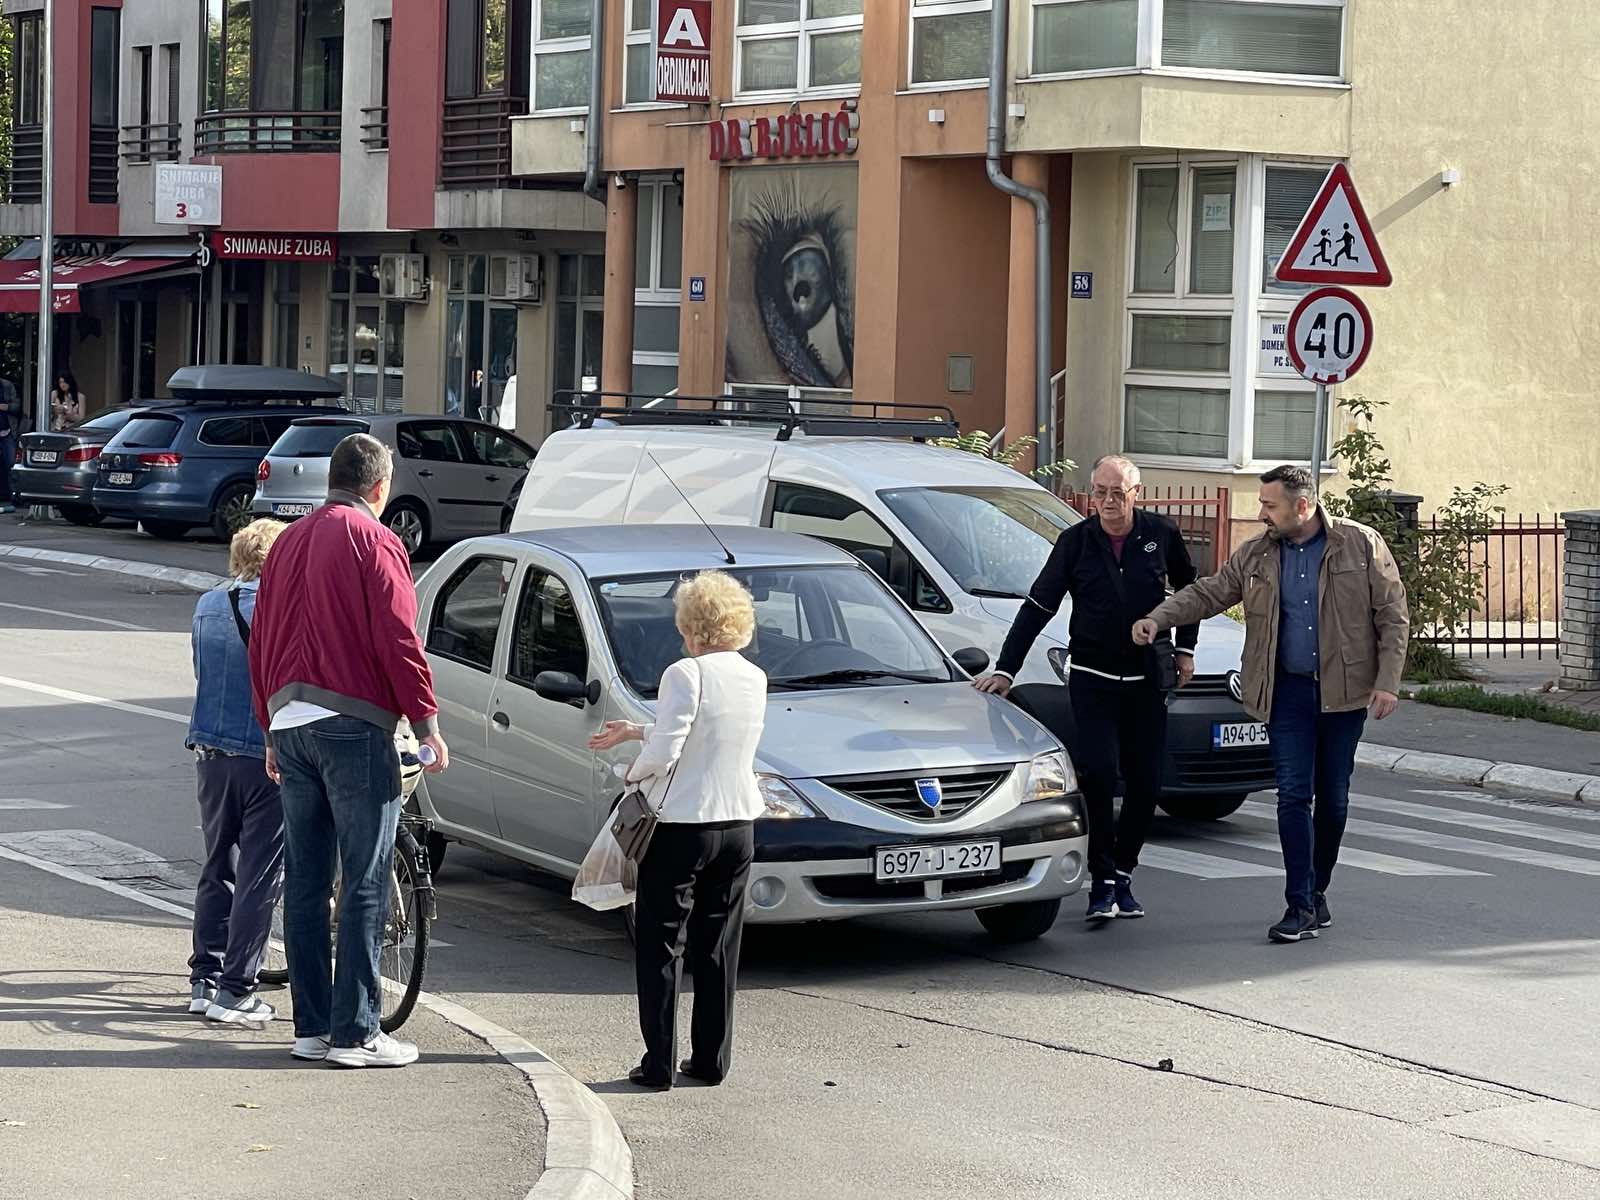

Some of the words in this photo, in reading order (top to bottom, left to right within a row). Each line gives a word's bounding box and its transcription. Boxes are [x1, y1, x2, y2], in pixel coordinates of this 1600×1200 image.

[662, 8, 705, 47] A
[657, 56, 710, 97] ORDINACIJA
[709, 118, 749, 161] DR
[756, 101, 856, 159] BJELIĆ
[160, 169, 219, 184] SNIMANJE
[223, 237, 292, 256] SNIMANJE
[295, 239, 332, 256] ZUBA
[691, 279, 704, 293] 60
[1074, 275, 1089, 290] 58
[1261, 339, 1286, 351] DOMEN
[1303, 312, 1356, 360] 40
[1274, 355, 1283, 367] PC
[883, 845, 994, 875] 697-J-237
